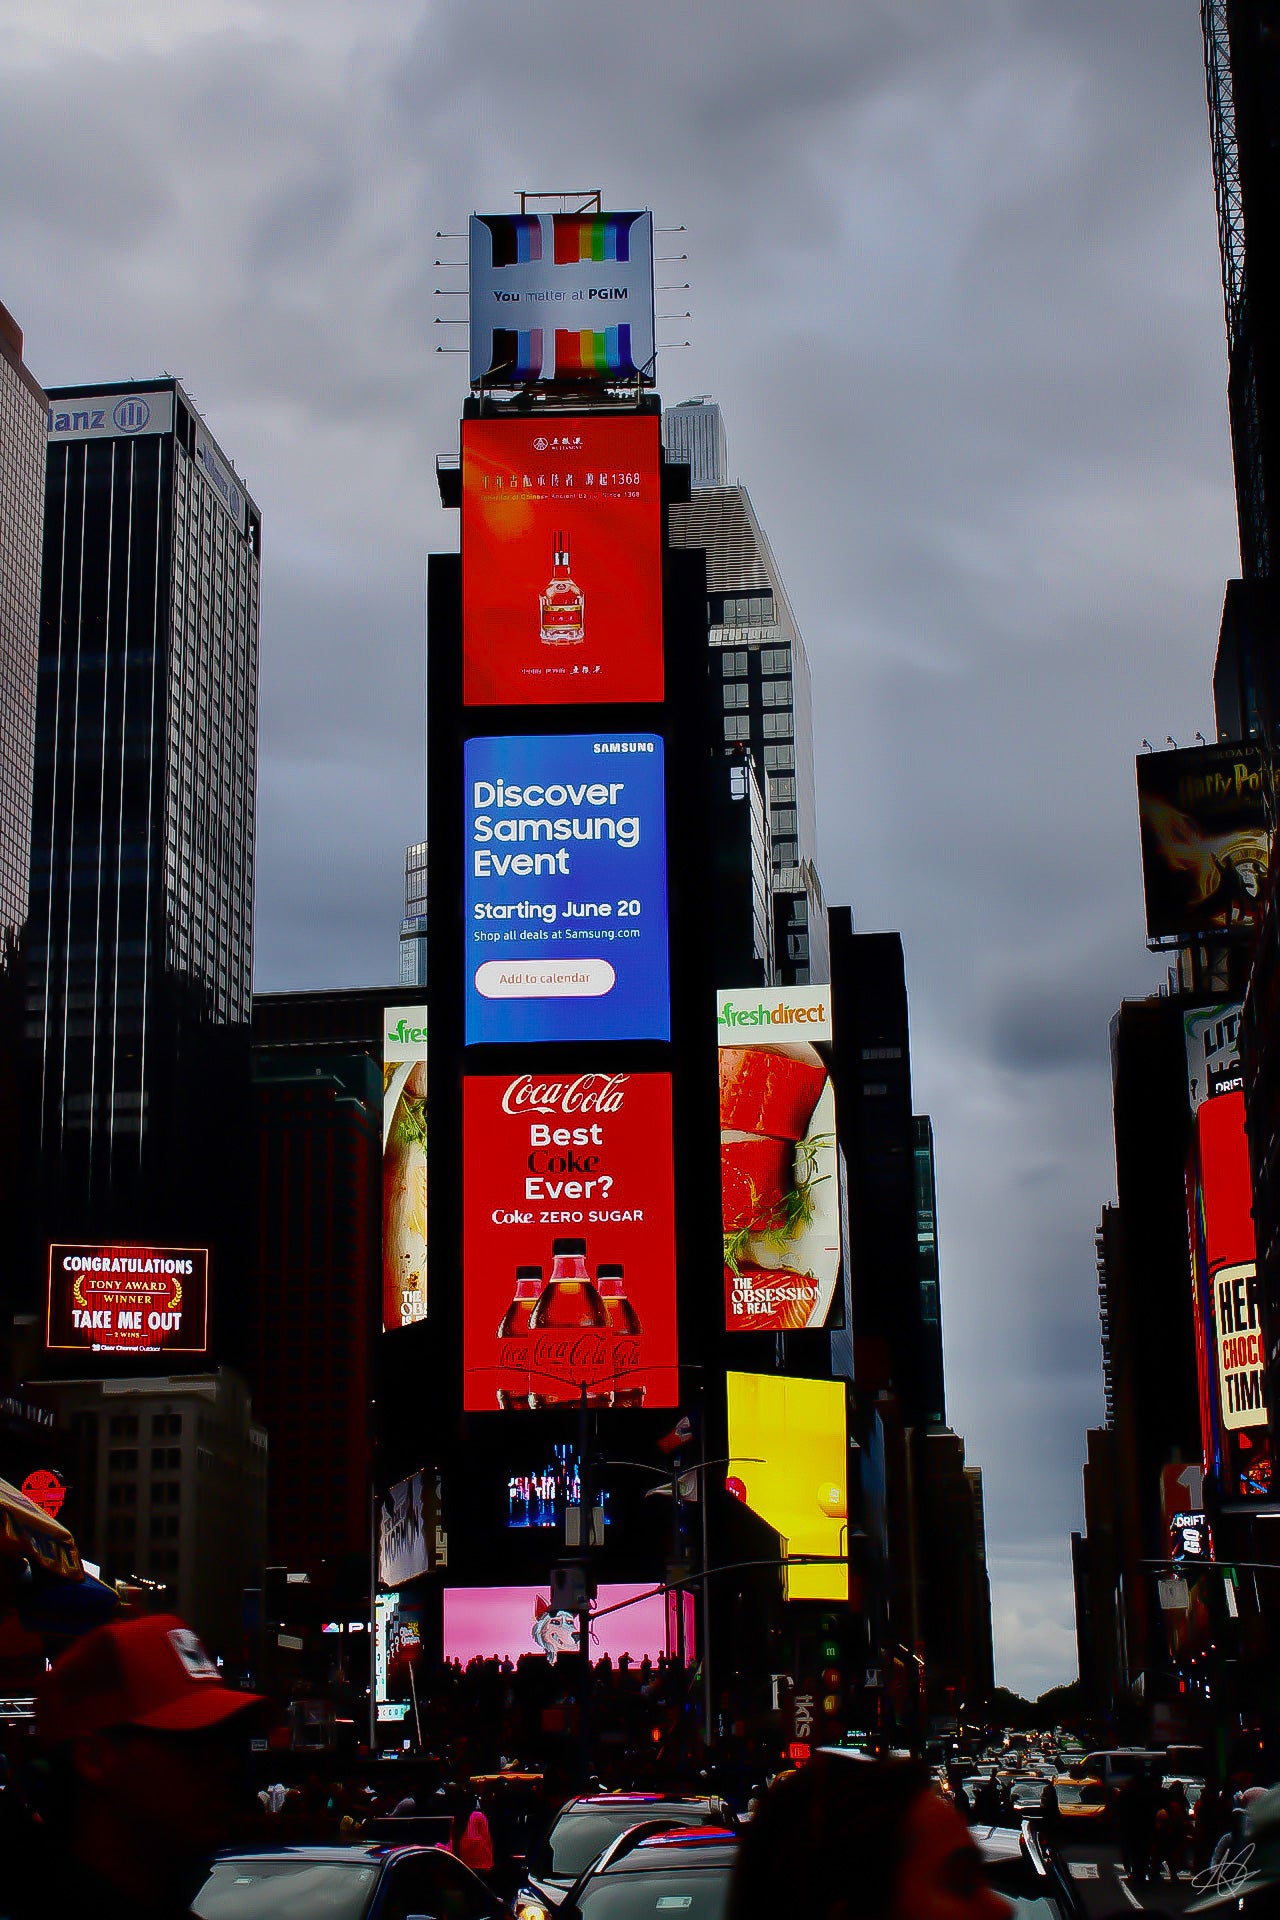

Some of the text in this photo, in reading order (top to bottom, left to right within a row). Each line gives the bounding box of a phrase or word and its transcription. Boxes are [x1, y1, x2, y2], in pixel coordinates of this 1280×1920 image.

[493, 287, 628, 302] You matter at PGIM
[593, 742, 654, 753] SAMSUNG
[473, 778, 625, 808] Discover
[473, 815, 641, 848] Samsung
[474, 848, 570, 877] Event
[473, 900, 641, 923] Starting June 20
[473, 928, 641, 942] Shop all deals at Samsung.com
[499, 972, 591, 984] Add to calendar
[722, 1002, 826, 1027] freshdirect
[502, 1072, 630, 1115] Coca-Cola
[1215, 1077, 1243, 1094] DRIFT
[530, 1123, 603, 1147] Best
[527, 1150, 600, 1174] Coke
[525, 1175, 614, 1200] Ever?
[491, 1209, 644, 1225] Coke ZERO SUGAR
[63, 1256, 193, 1275] CONGRATULATIONS
[89, 1280, 167, 1291] TONY AWARD
[733, 1277, 753, 1290] THE
[103, 1294, 152, 1304] WINNER
[402, 1290, 421, 1303] THE
[731, 1286, 822, 1303] OBSESSION
[400, 1302, 427, 1316] OB
[733, 1302, 776, 1315] IS REAL
[72, 1309, 182, 1331] TAKE ME OUT
[1225, 1369, 1263, 1414] TIM
[1175, 1514, 1206, 1528] DRIFT
[826, 1647, 836, 1656] m
[795, 1694, 814, 1738] tkts
